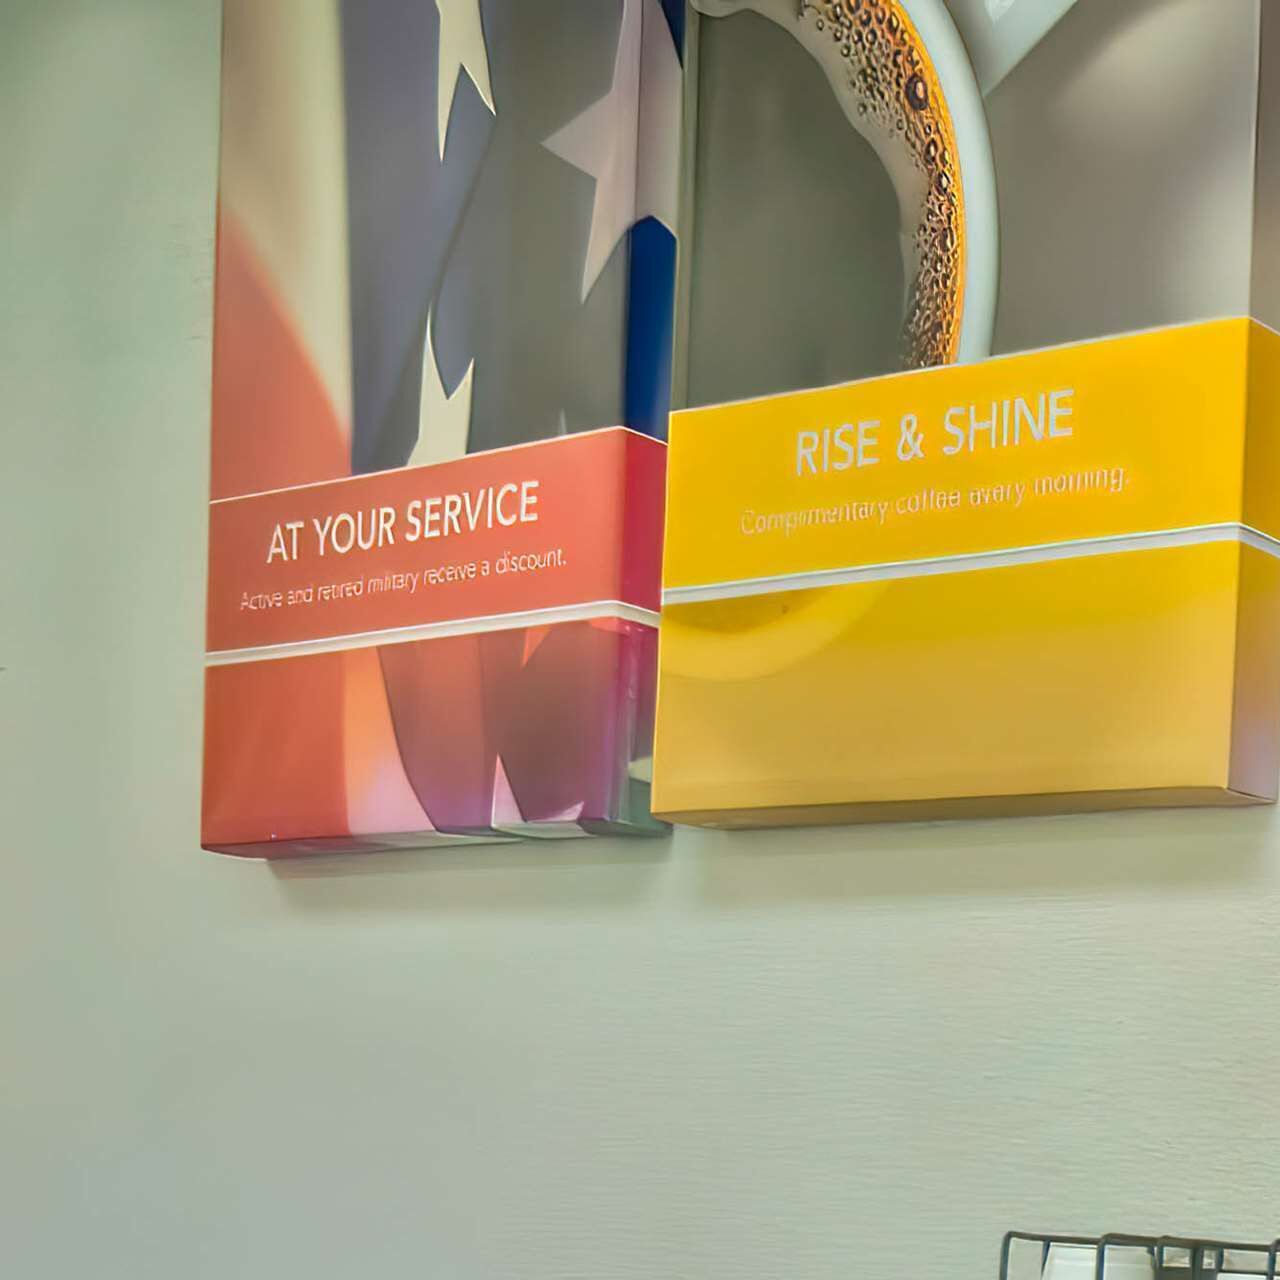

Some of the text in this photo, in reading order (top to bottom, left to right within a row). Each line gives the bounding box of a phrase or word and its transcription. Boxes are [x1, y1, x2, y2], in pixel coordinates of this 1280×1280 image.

[795, 388, 1075, 477] RISE & SHINE
[266, 480, 540, 563] AT YOUR SERVICE
[896, 487, 961, 514] coffee
[968, 480, 1026, 508] every
[240, 548, 567, 611] Active and retired military receive a discount.
